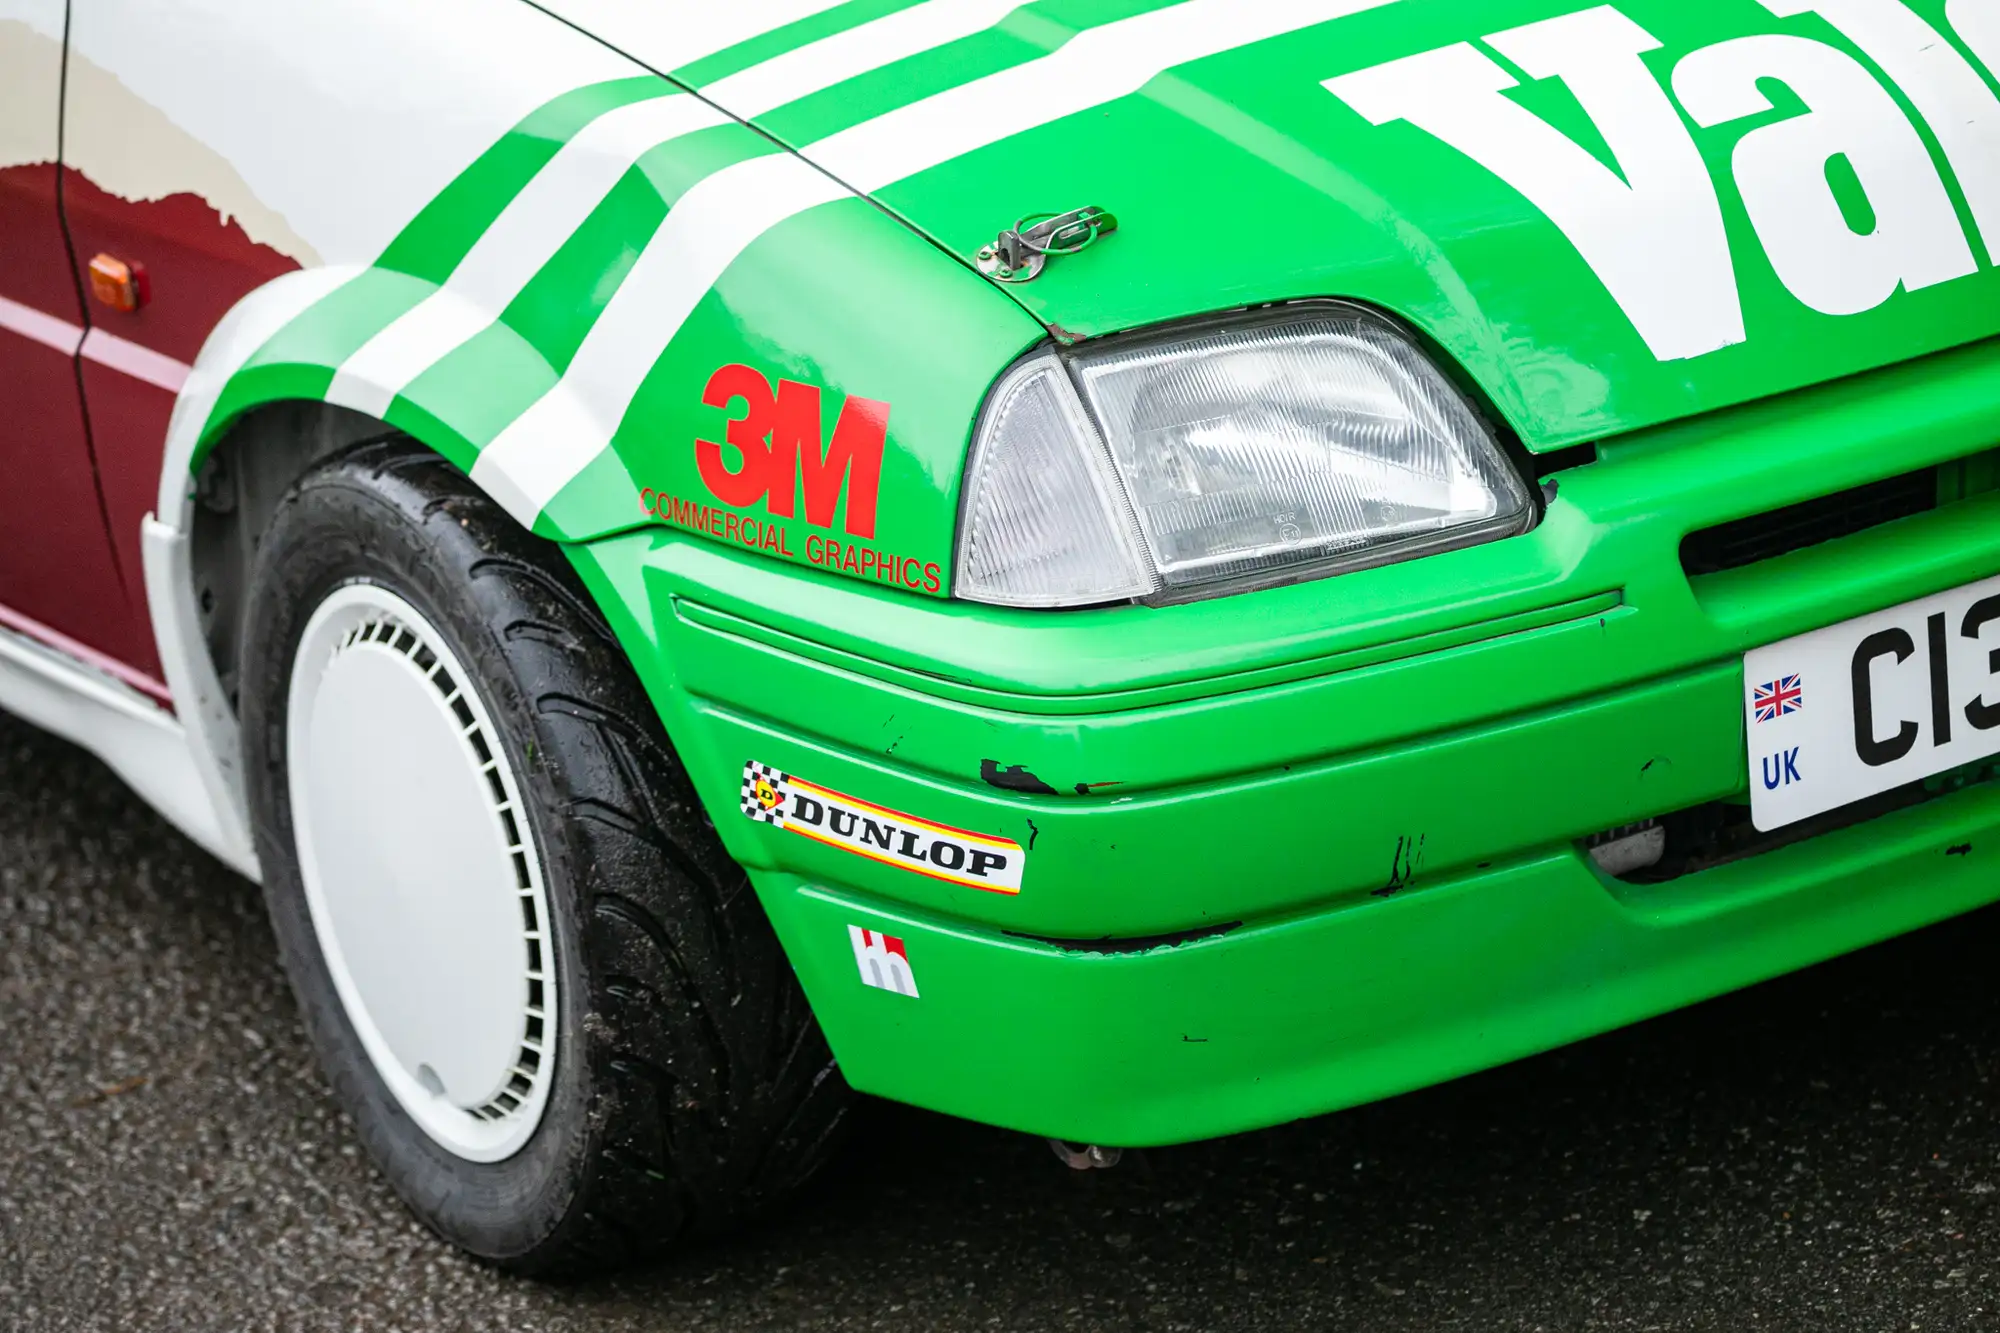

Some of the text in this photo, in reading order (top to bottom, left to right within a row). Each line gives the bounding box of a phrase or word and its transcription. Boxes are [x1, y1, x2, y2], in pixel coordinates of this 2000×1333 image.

[1319, 0, 2000, 361] Val
[695, 363, 891, 540] 3M
[639, 487, 941, 592] COMMERCIAL GRAPHICS
[1762, 746, 1802, 790] UK
[791, 793, 1007, 877] DUNLOP
